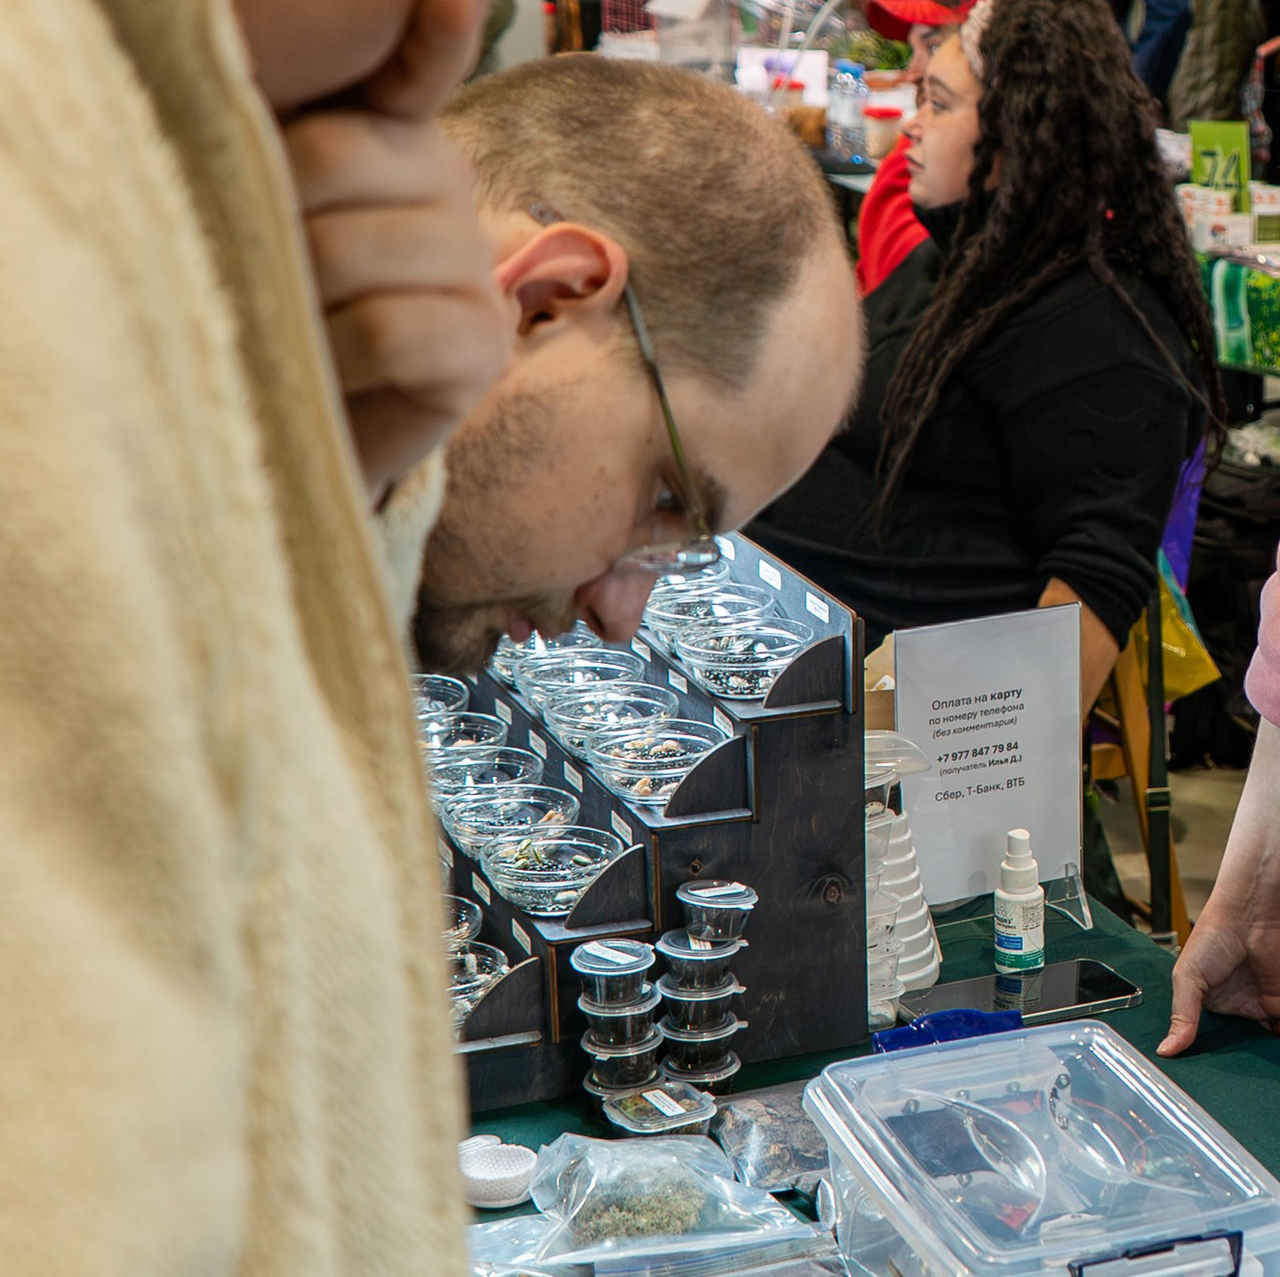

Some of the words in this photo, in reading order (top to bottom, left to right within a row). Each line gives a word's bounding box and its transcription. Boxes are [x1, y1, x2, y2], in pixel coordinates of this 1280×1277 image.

[931, 696, 972, 711] Оплата
[974, 694, 988, 704] на
[990, 688, 1023, 701] карту
[928, 716, 941, 726] по
[942, 710, 978, 724] номеру
[979, 702, 1025, 717] телефона
[932, 727, 951, 740] (без
[952, 716, 1018, 735] комментария)
[936, 753, 950, 764] +7
[951, 750, 970, 761] 977
[971, 745, 991, 758] 847
[992, 743, 1004, 754] 79
[1006, 741, 1019, 751] 84
[939, 762, 987, 777] (получатель
[988, 757, 1009, 767] Илья
[1009, 754, 1023, 765] Д.)
[935, 790, 965, 802] Сбер,
[967, 782, 1005, 796] Т-Банк,
[1006, 776, 1026, 789] ВТБ
